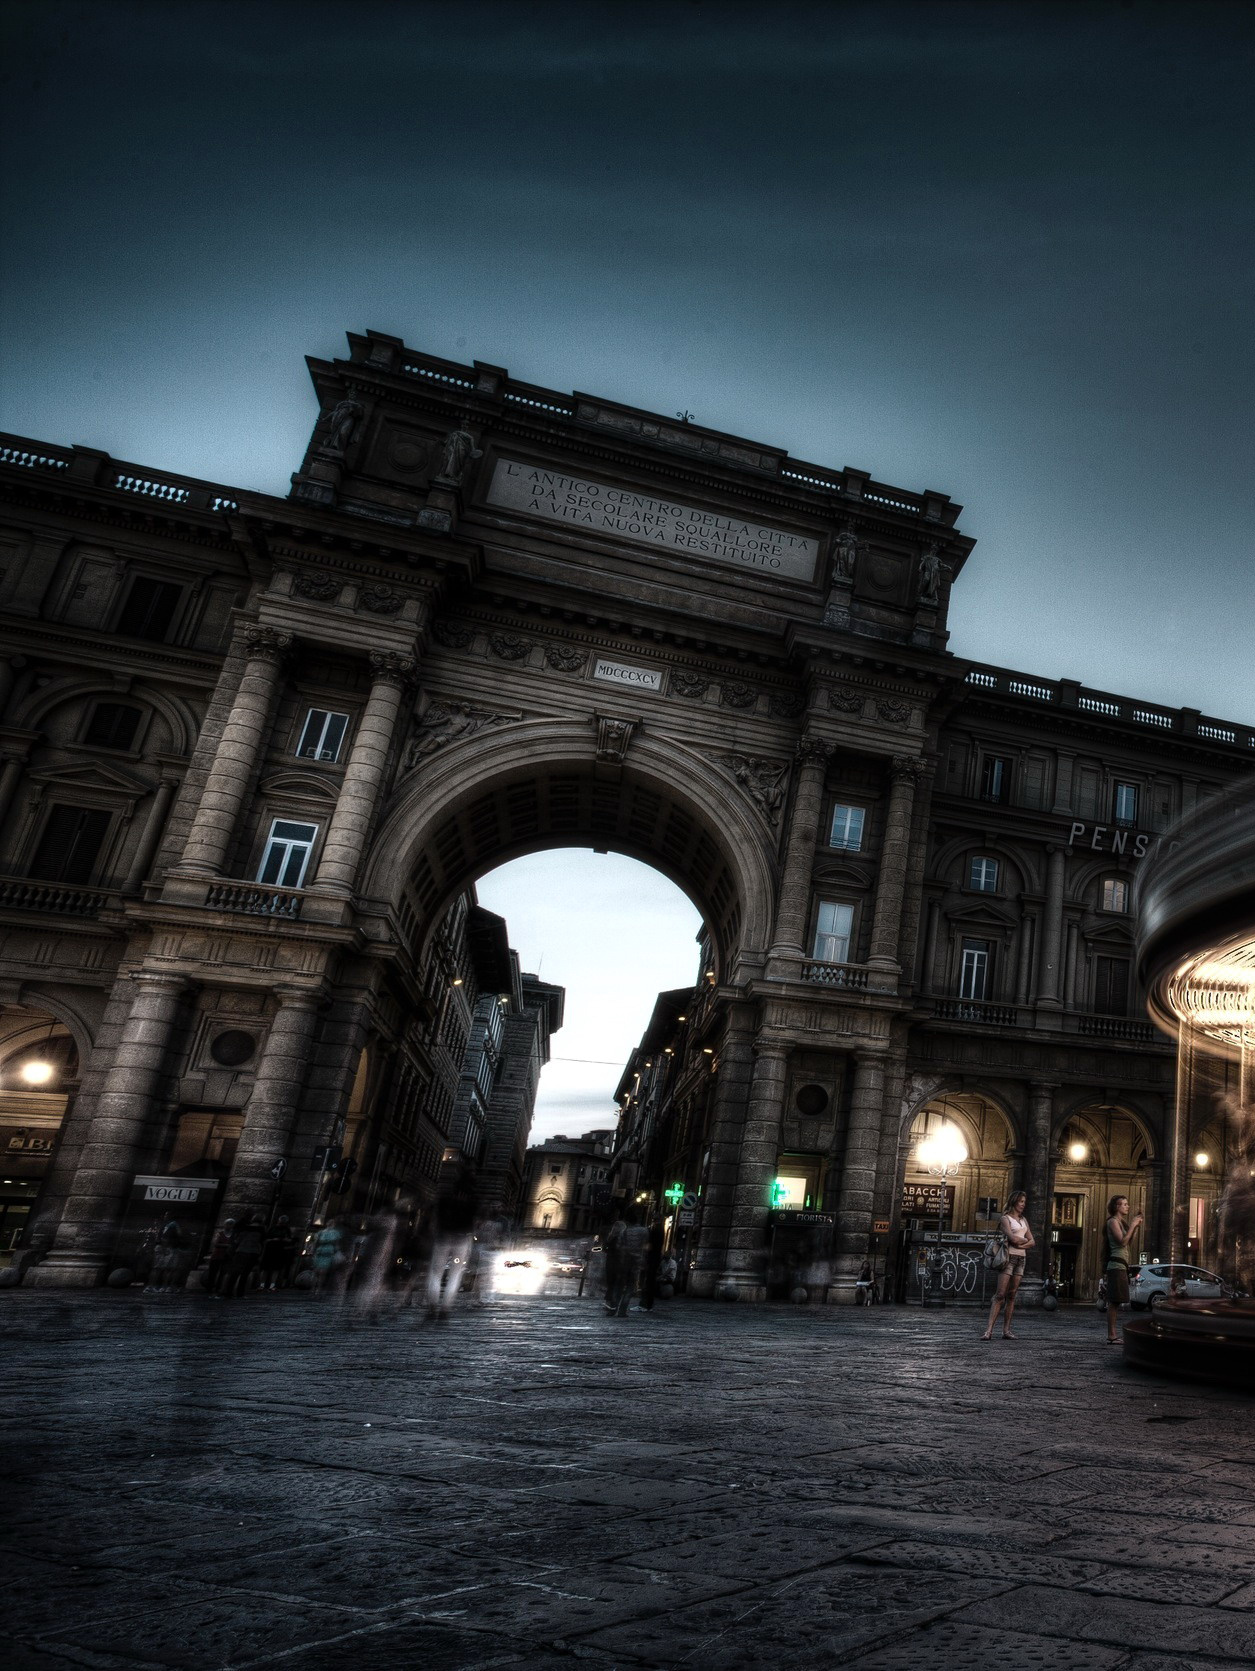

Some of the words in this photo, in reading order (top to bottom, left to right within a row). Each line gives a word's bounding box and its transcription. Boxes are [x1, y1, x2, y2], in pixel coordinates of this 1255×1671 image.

[528, 471, 600, 497] ANTICO
[607, 490, 683, 518] CENTRO
[690, 511, 750, 536] DELLA
[531, 484, 557, 500] DA
[566, 493, 668, 528] SECOLARE
[674, 521, 783, 557] SQUALLORE
[528, 499, 540, 510] A
[550, 502, 593, 523] VITA
[602, 515, 666, 541] NUOVA
[674, 533, 781, 569] RESTITUITO
[597, 665, 658, 685] MDCCCXCV
[149, 1187, 198, 1201] VOGUE
[902, 1186, 948, 1197] ABACCHI
